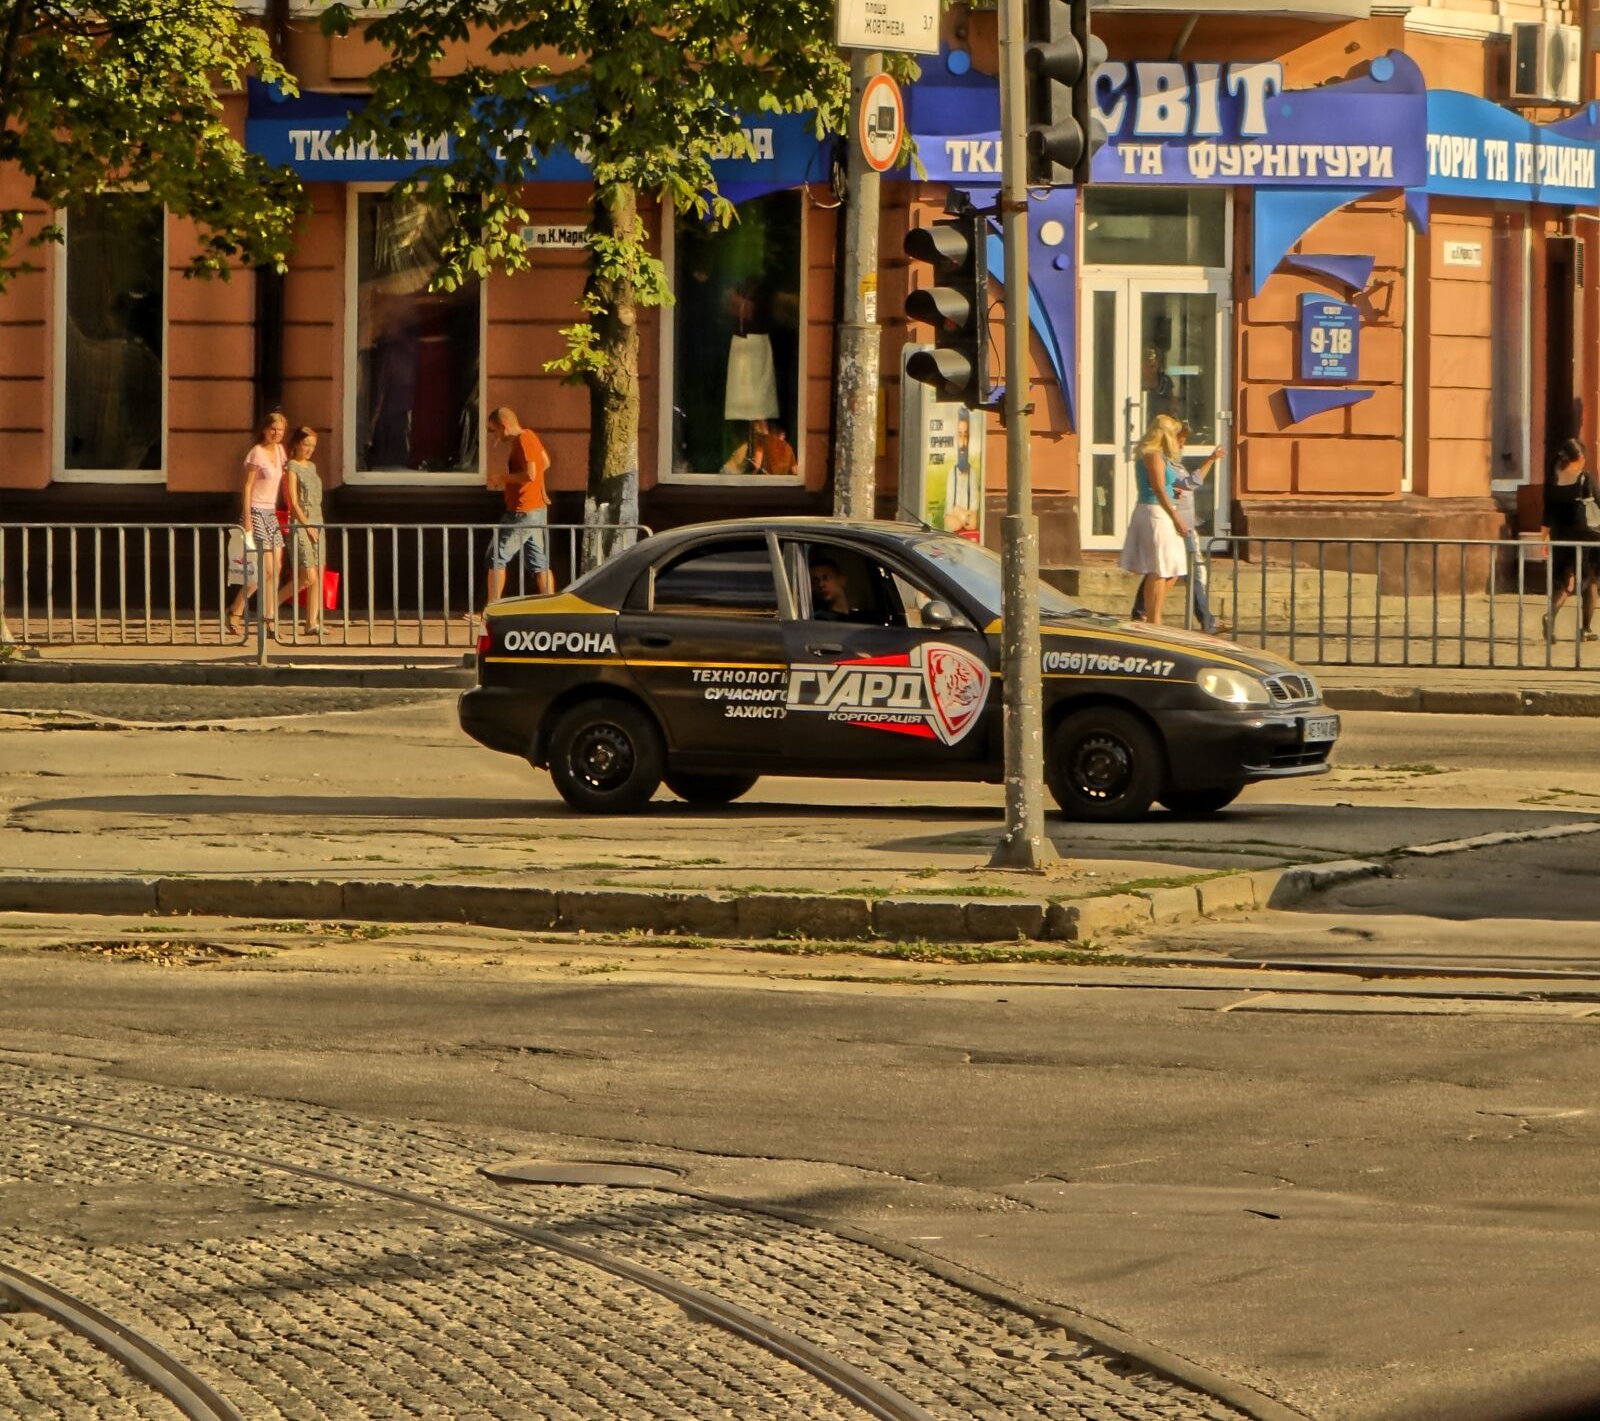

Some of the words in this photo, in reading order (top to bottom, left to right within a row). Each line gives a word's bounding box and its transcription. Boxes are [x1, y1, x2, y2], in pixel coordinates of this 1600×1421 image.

[864, 18, 905, 36] ЖОВТНЕВА
[1091, 61, 1282, 137] СВІТ
[1118, 142, 1164, 176] ТА
[1187, 140, 1394, 179] ФУРНІТУРИ
[1426, 134, 1477, 179] ТОРИ
[1483, 139, 1509, 182] ТА
[1515, 142, 1595, 189] ГАРДИНИ
[1311, 328, 1352, 354] 9-18
[504, 631, 617, 653] ОХОРОНА
[1042, 651, 1175, 676] (056)766-07-17
[786, 670, 922, 708] ГУАРД
[724, 705, 788, 719] ЗАХИСТУ
[828, 712, 922, 724] КОРПОРАЦІЯ
